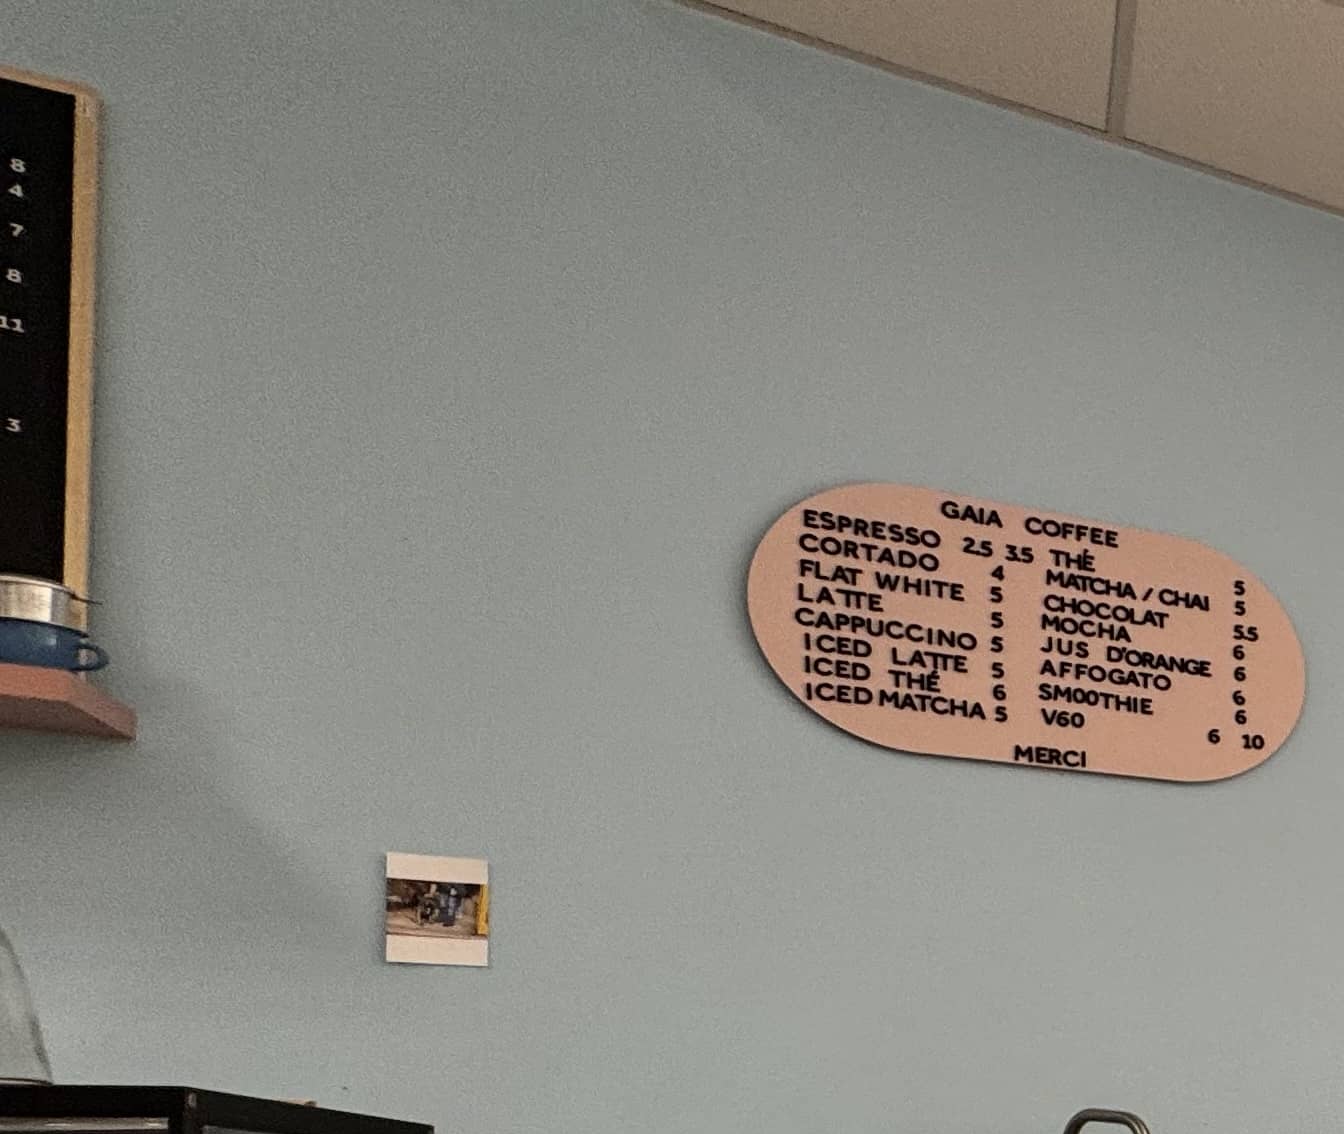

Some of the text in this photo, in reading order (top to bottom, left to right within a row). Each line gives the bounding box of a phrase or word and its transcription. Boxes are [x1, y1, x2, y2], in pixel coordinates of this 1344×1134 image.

[6, 418, 21, 433] 3
[803, 509, 941, 548] ESPRESSO
[940, 500, 1119, 548] GAIA COFFEE
[799, 533, 1005, 581] CORTADO 4
[1049, 548, 1245, 596] THÉ 5
[799, 559, 1003, 603] FLAT WHITE 5
[1045, 569, 1137, 601] MATCHA
[1159, 588, 1210, 612] CHAI
[1233, 601, 1246, 616] 5
[797, 582, 1004, 629] LATTE 5
[1043, 594, 1170, 629] CHOCOLAT
[794, 607, 1004, 653] CAPPUCCINO 5
[1041, 614, 1245, 660] MOCHA 6
[804, 632, 1005, 679] ICED LATTE 5
[804, 655, 1007, 701] ICED THÉ 6
[1040, 636, 1246, 682] JUS D'ORANGE 6
[806, 682, 1008, 722] ICED MATCHA 5
[1038, 683, 1247, 725] SMOOTHIE 6
[1040, 659, 1246, 706] AFFOGATO 6
[1040, 708, 1265, 750] V60 6 10
[1013, 744, 1087, 768] MERCI
